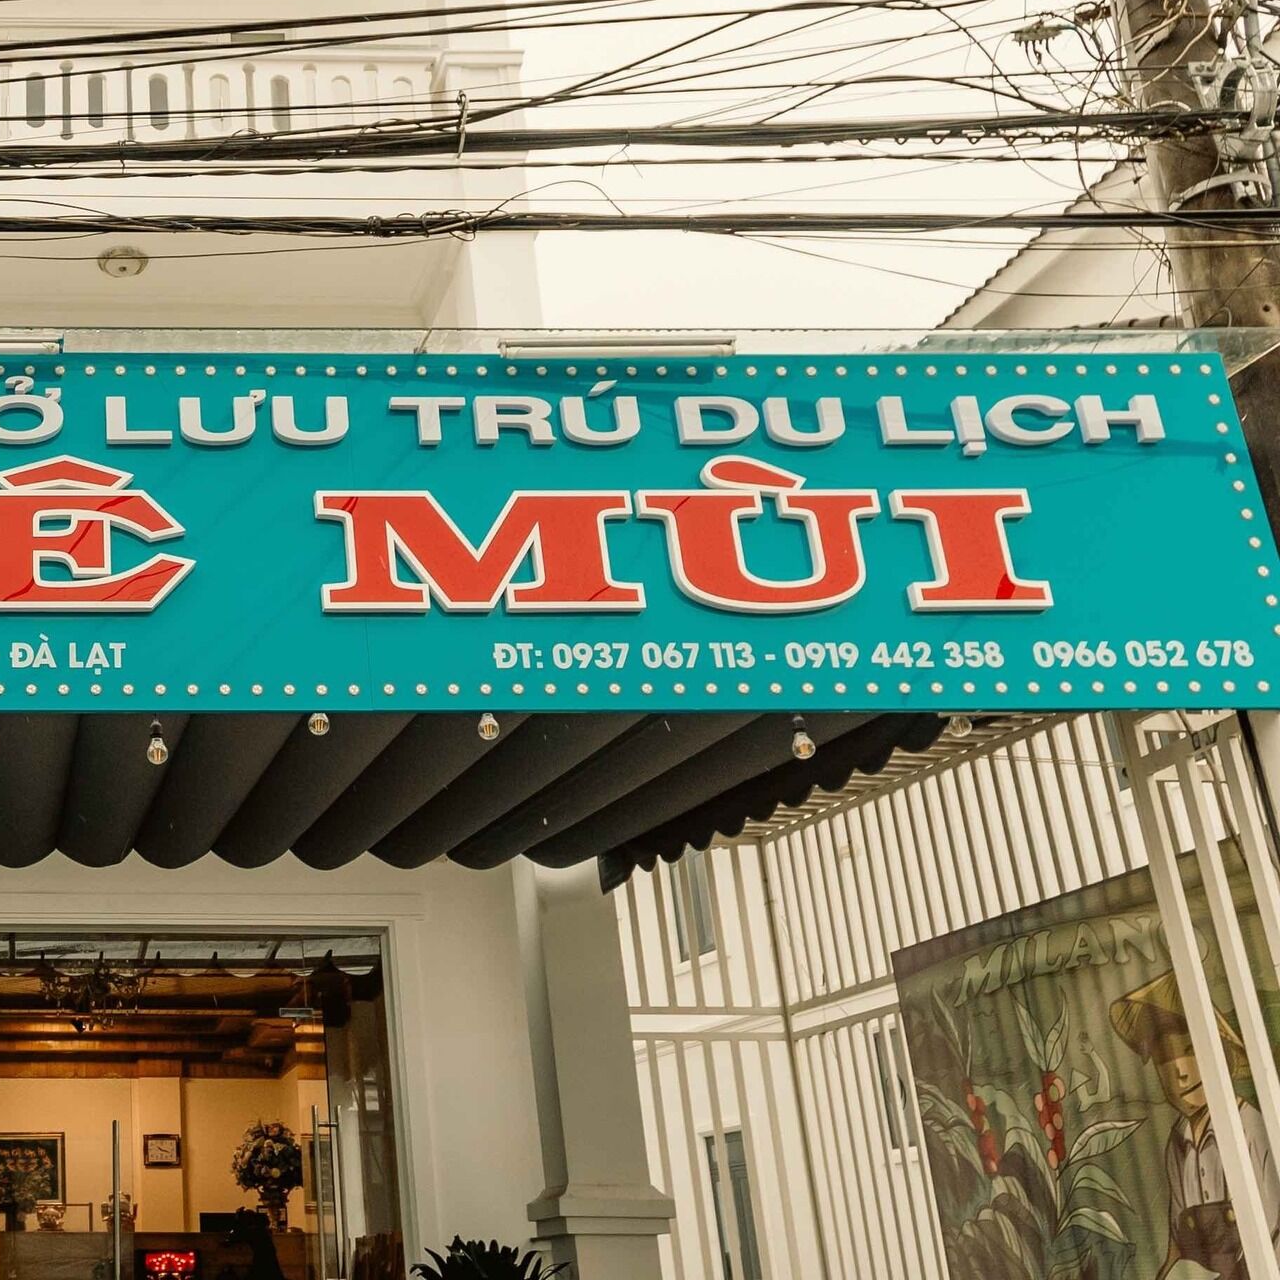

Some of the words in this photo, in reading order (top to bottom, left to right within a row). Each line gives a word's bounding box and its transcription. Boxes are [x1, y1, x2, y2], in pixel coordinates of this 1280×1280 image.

[106, 388, 349, 446] LƯU
[389, 379, 640, 446] TRÚ
[674, 395, 846, 447] DU
[877, 393, 1166, 457] LỊCH
[314, 454, 1054, 614] MÙI
[9, 633, 57, 668] ĐÀ
[68, 641, 126, 675] LẠT
[493, 642, 544, 669] ĐT:
[552, 642, 630, 669] 0937
[641, 642, 700, 669] 067
[708, 642, 755, 669] 113
[784, 642, 860, 669] 0919
[871, 641, 935, 668] 442
[942, 641, 1005, 668] 358
[1032, 640, 1117, 668] 0966
[1124, 640, 1188, 668] 052
[1195, 640, 1255, 668] 678
